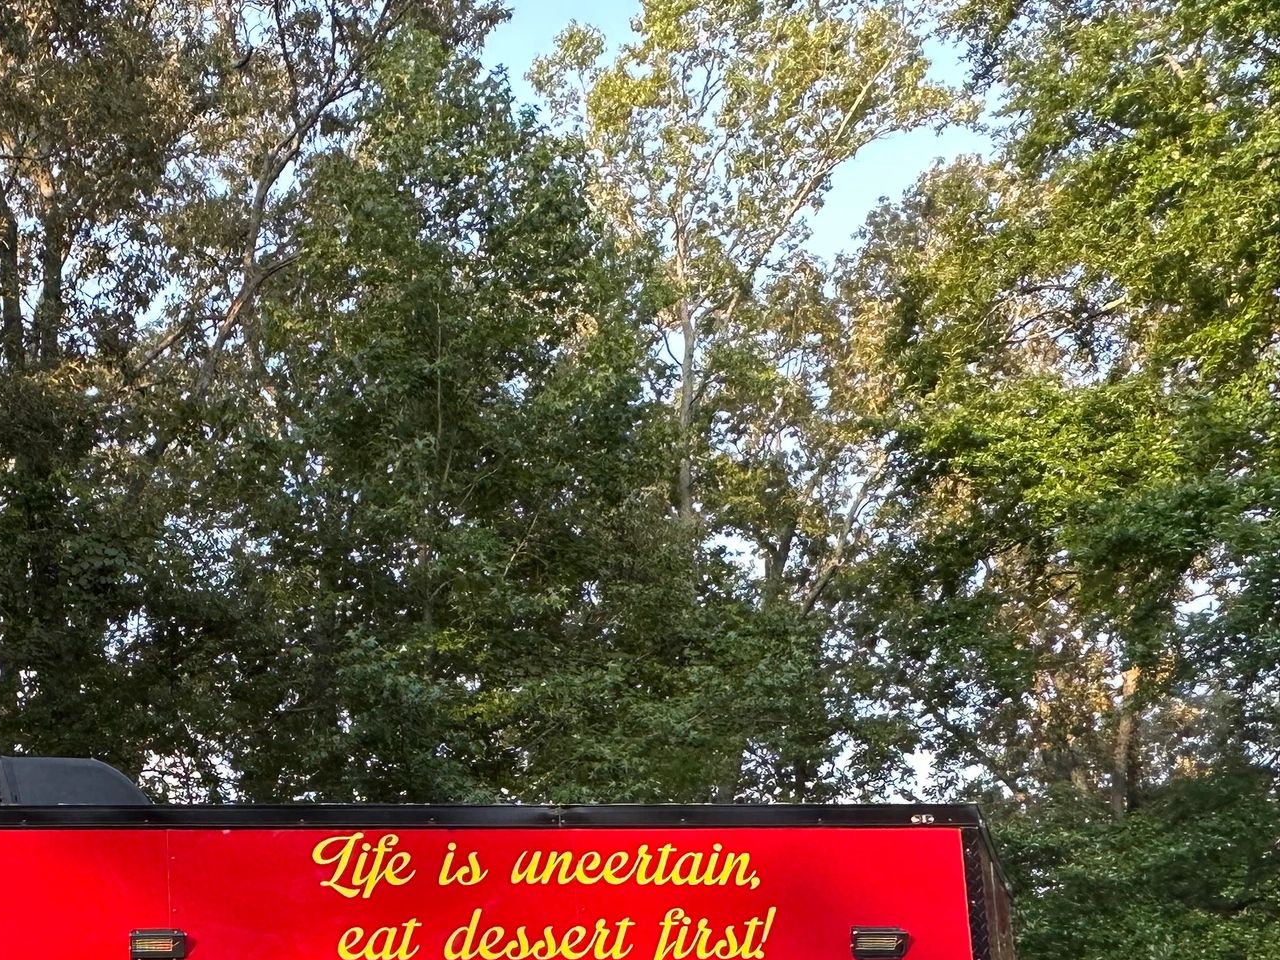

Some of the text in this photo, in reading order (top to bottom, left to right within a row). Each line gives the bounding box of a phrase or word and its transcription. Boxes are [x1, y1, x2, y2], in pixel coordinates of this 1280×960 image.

[311, 832, 762, 899] Life is uncertain,
[443, 908, 637, 960] dessert
